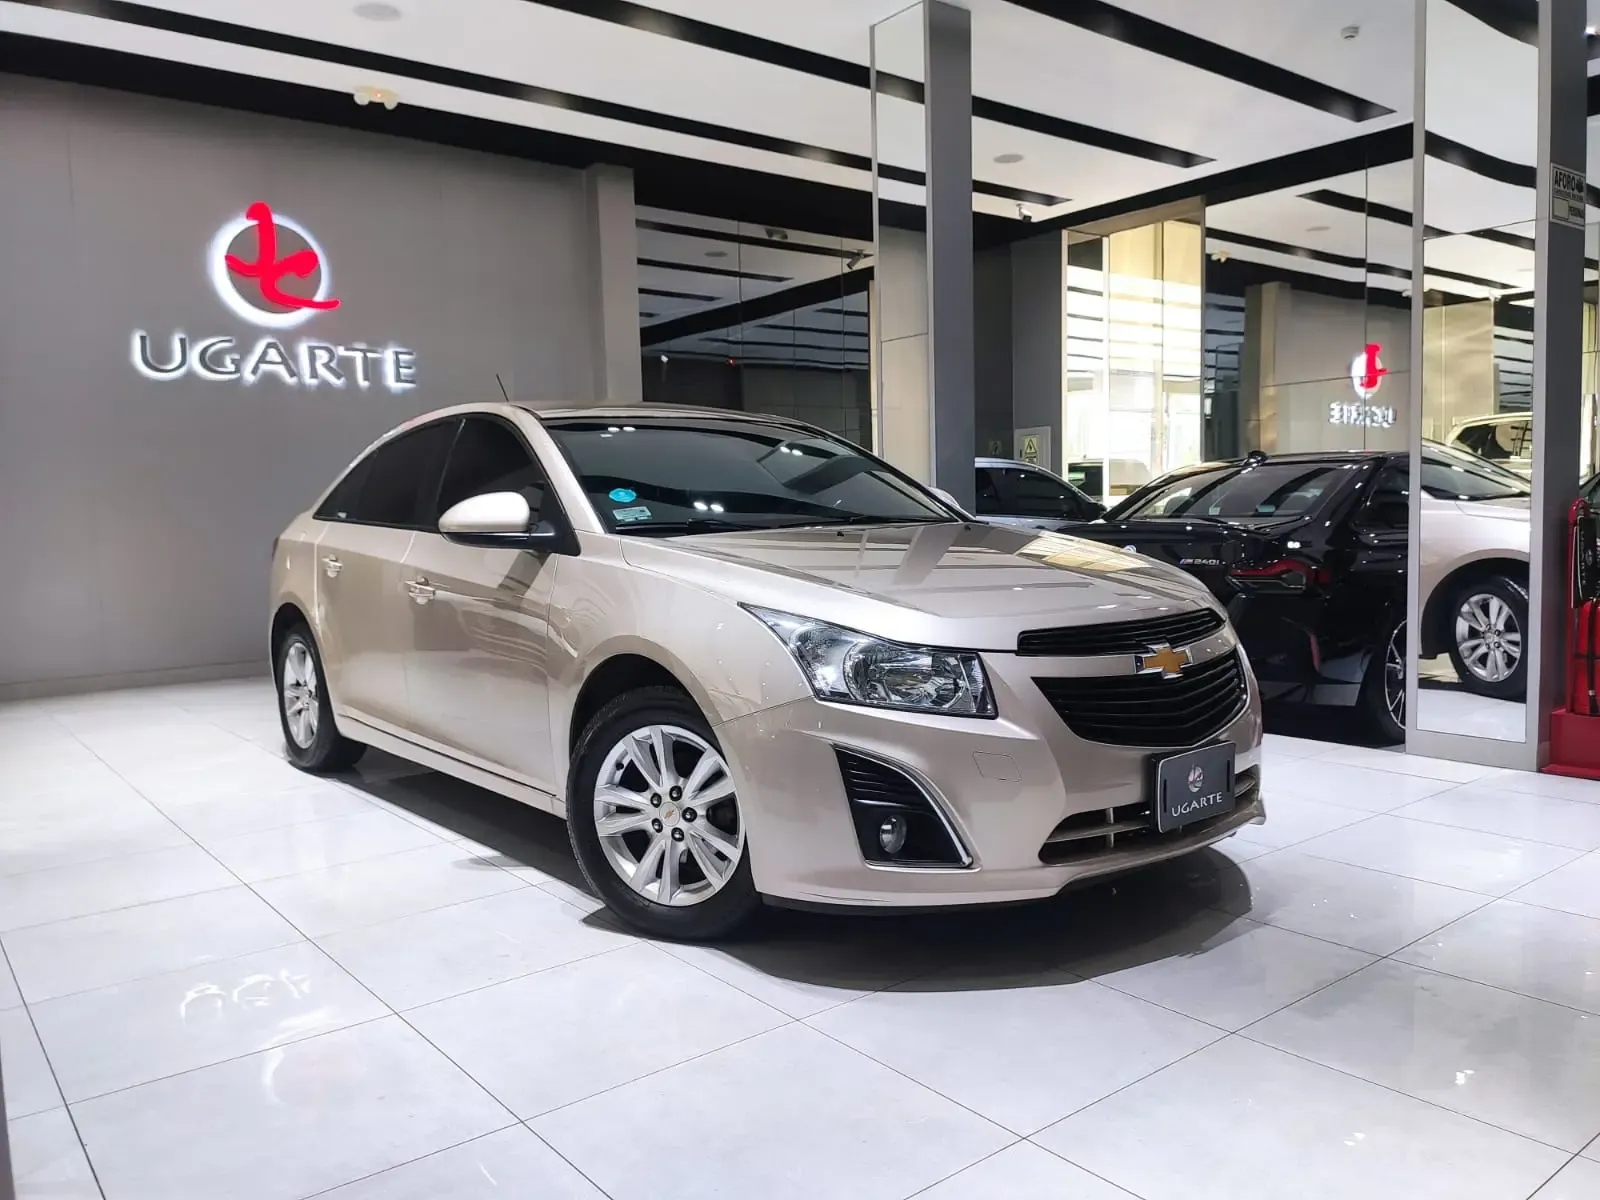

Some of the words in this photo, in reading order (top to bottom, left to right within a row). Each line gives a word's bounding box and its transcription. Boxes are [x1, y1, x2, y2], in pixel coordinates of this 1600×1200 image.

[1554, 170, 1576, 192] AFORO
[133, 331, 417, 388] UGARTE
[1171, 791, 1223, 817] UGARTE
